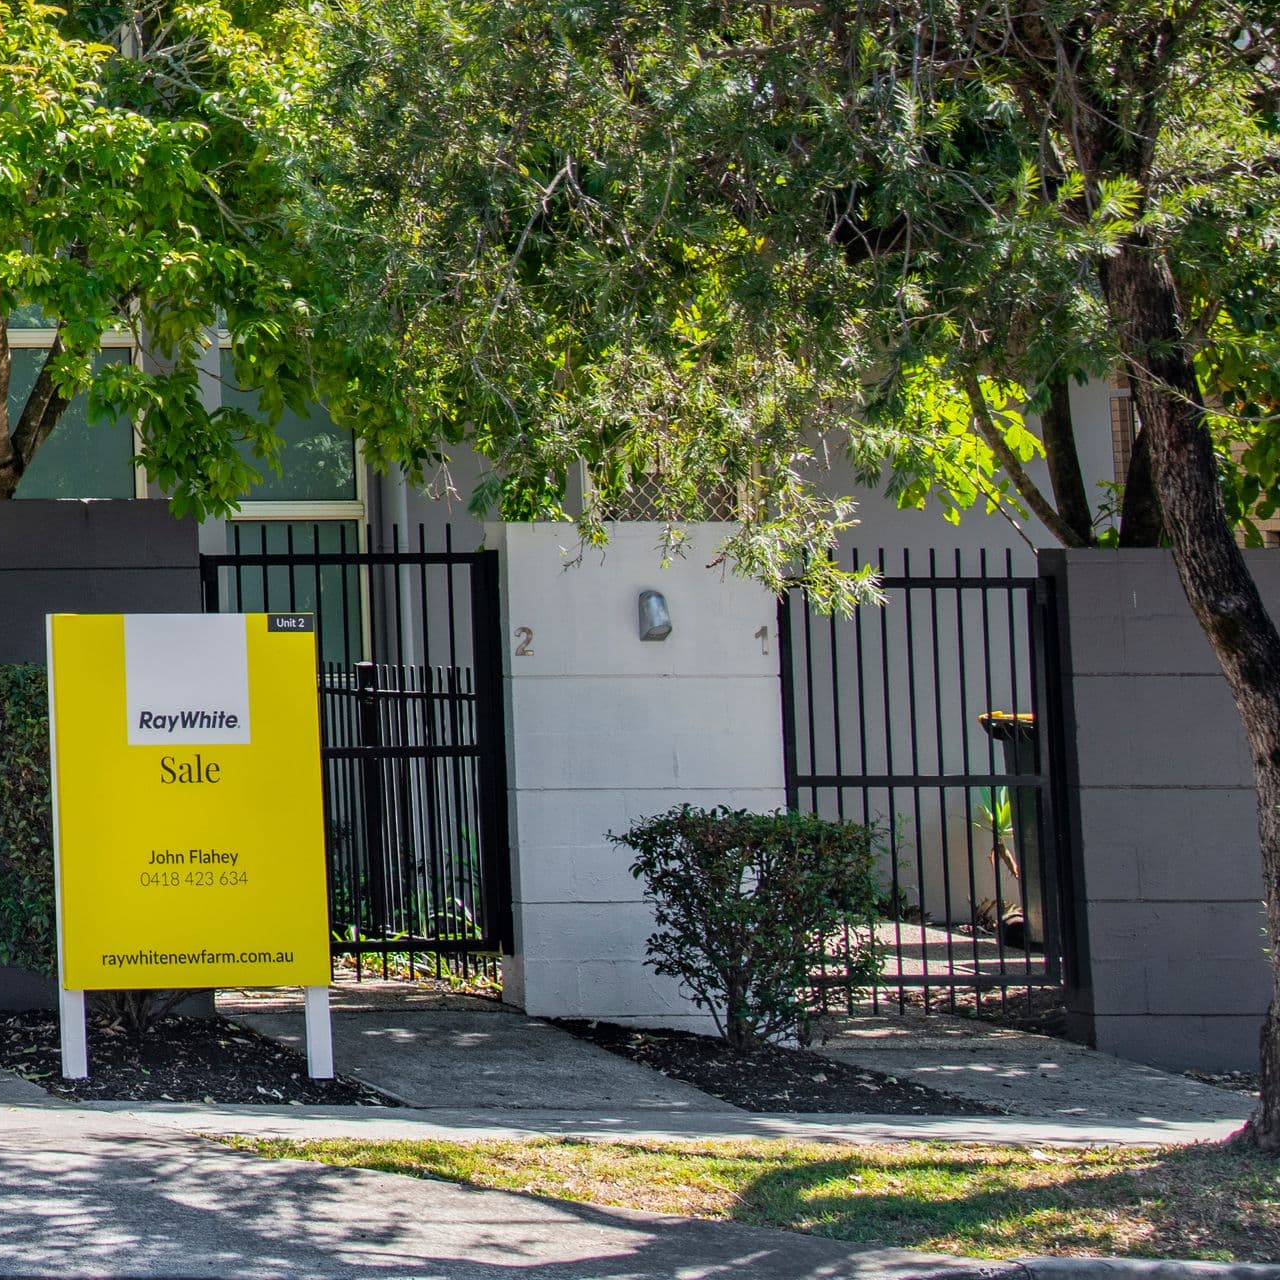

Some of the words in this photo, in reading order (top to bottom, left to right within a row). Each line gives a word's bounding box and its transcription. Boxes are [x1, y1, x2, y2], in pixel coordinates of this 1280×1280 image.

[276, 617, 297, 628] Unit
[298, 618, 305, 628] 2
[514, 626, 535, 656] 2
[755, 626, 769, 655] 1
[160, 753, 221, 785] Sale
[148, 849, 185, 865] John
[189, 848, 239, 866] Flahey
[140, 871, 180, 887] 0418
[184, 871, 214, 886] 423
[219, 871, 248, 886] 634
[101, 949, 294, 968] raywhitenewfarm.com.au
